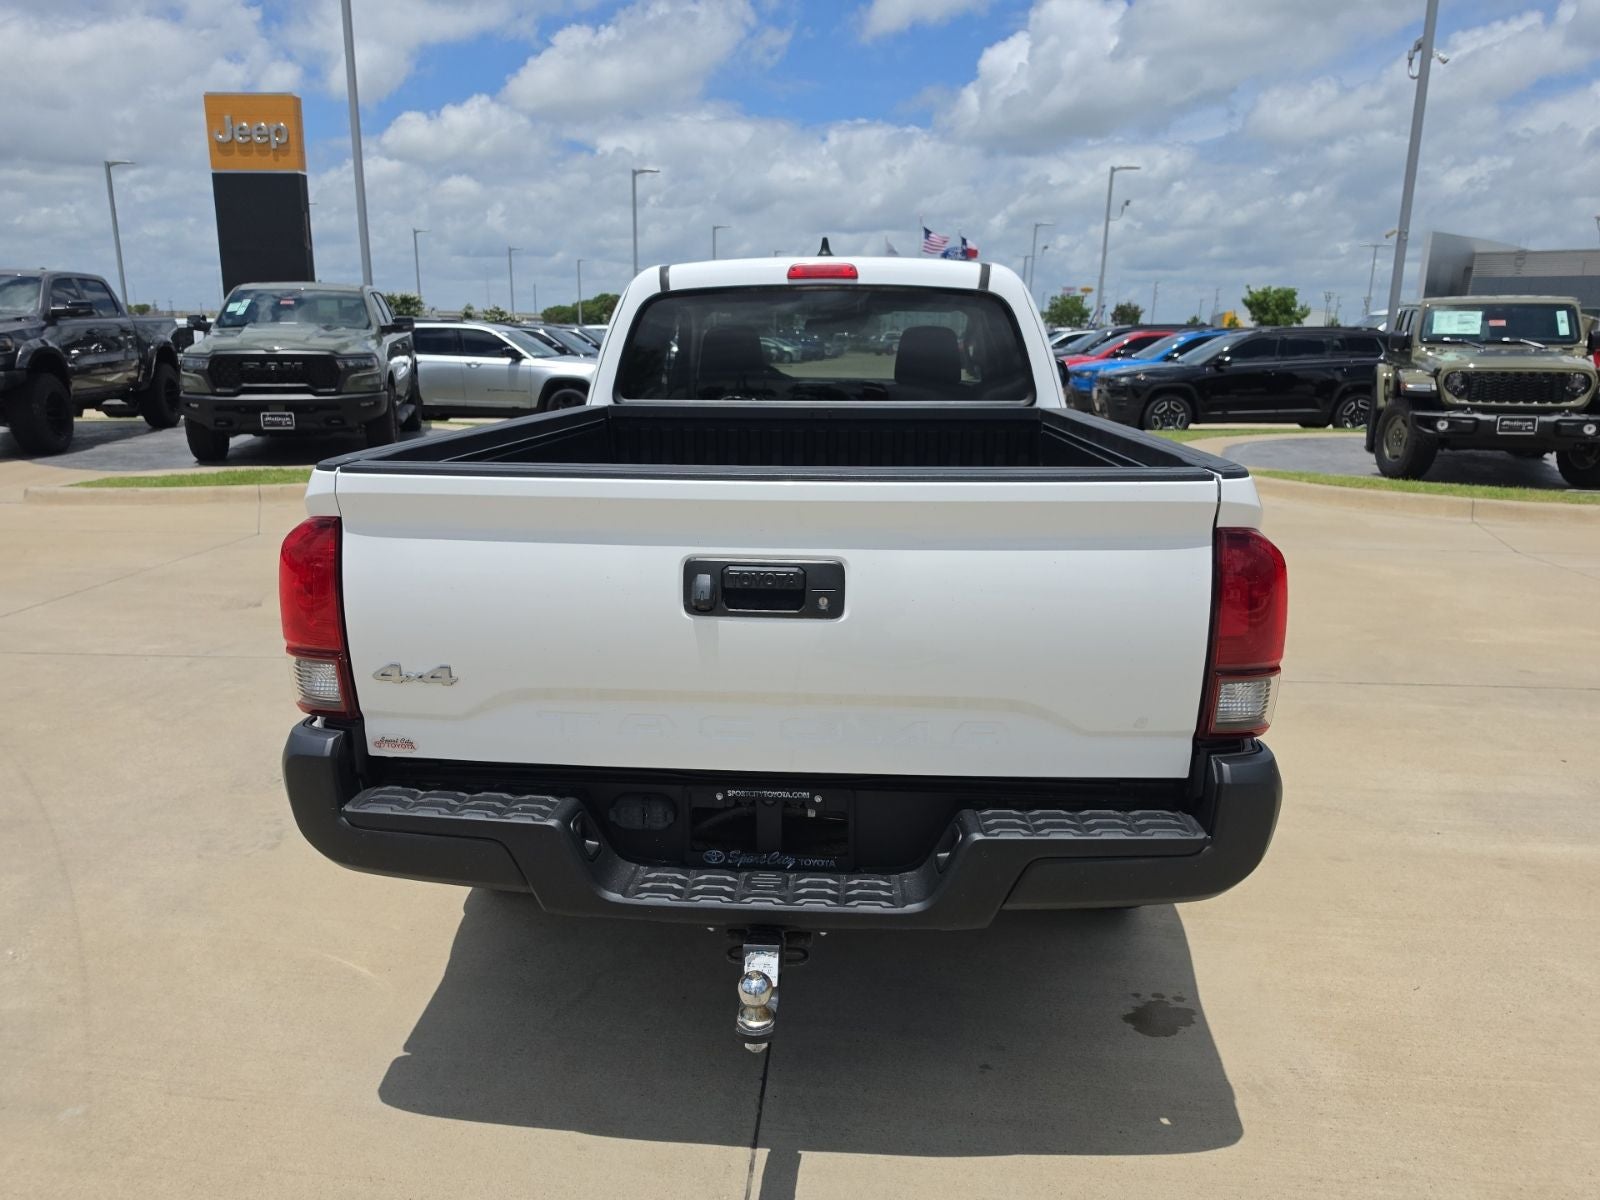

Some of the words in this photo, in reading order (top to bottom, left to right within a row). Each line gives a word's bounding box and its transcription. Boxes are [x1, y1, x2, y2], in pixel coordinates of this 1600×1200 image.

[214, 114, 288, 149] Jeep
[728, 572, 797, 586] TOYOTA
[372, 662, 458, 687] 4x4
[387, 742, 417, 751] TOYOTA
[726, 789, 810, 799] SPORTCITYTOYOTA.COM
[767, 851, 796, 869] City
[799, 857, 837, 868] TOYOTA
